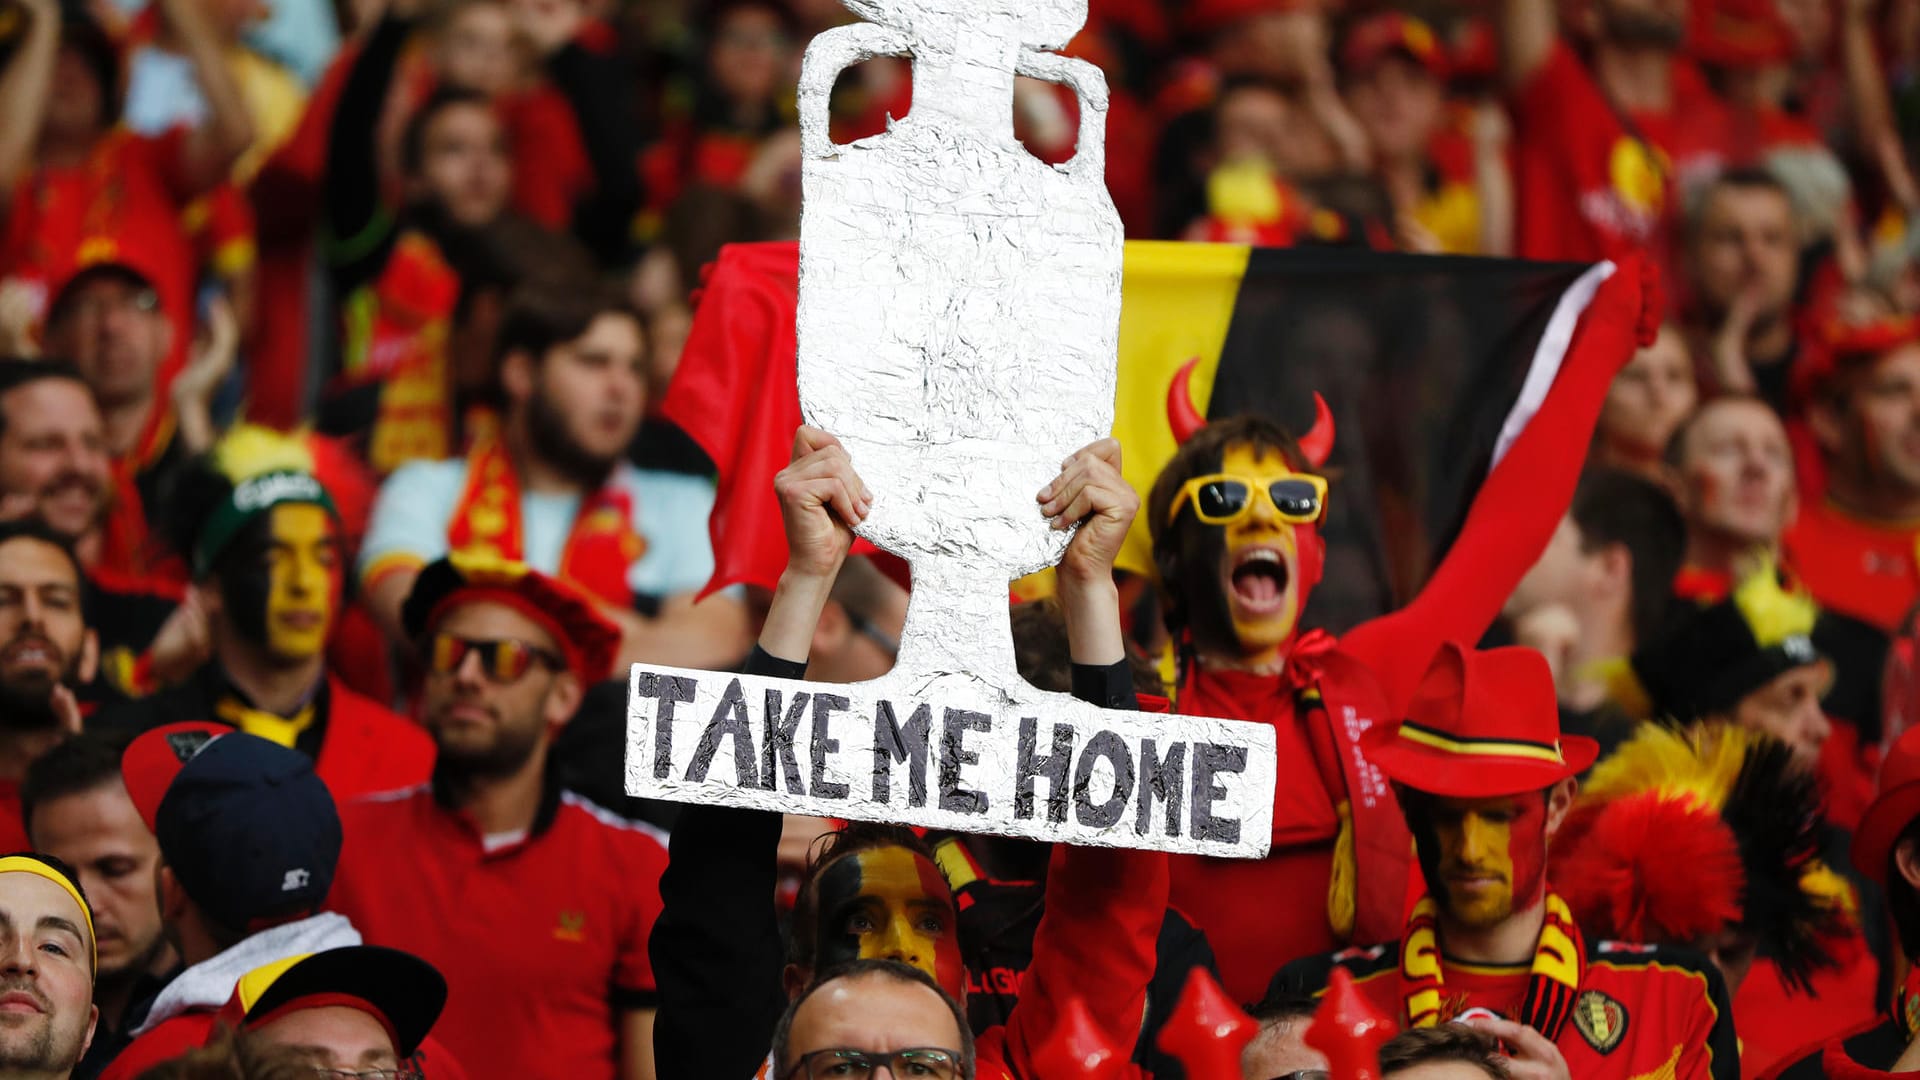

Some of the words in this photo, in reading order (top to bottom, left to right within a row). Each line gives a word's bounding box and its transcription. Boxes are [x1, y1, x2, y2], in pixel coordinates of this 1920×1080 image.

[638, 671, 851, 800] TAKE
[871, 699, 991, 816] ME
[1013, 716, 1249, 844] HOME
